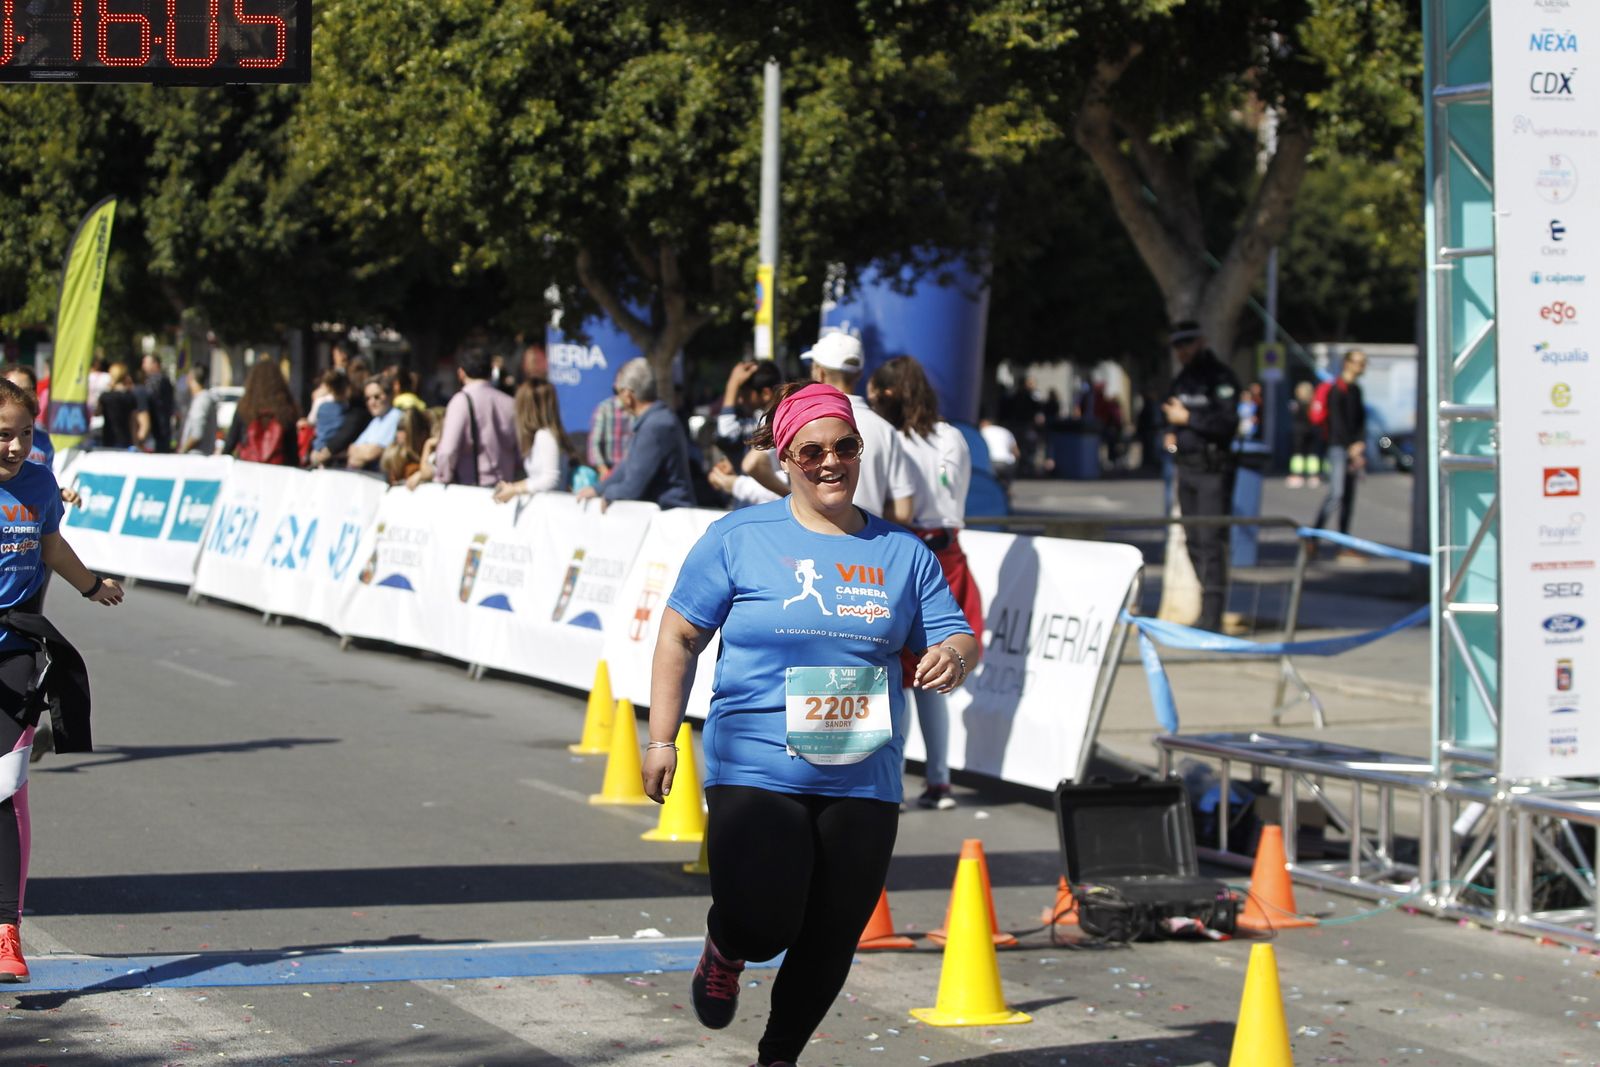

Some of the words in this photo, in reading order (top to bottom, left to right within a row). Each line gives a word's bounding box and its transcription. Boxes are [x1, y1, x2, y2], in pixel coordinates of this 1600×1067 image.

[1529, 33, 1578, 52] NEXA
[1530, 71, 1574, 94] CDX
[1545, 274, 1585, 284] cajamar
[1540, 301, 1576, 324] ego
[1541, 350, 1589, 365] aqualia
[835, 563, 885, 586] VIII
[835, 586, 889, 600] CARRERA
[1543, 582, 1583, 598] SER
[836, 594, 856, 602] DE
[838, 602, 890, 624] mujer
[786, 628, 827, 636] IGUALDAD
[838, 632, 872, 642] NUESTRA
[840, 669, 856, 677] VIII
[805, 696, 870, 720] 2203
[825, 720, 852, 728] SANDRY
